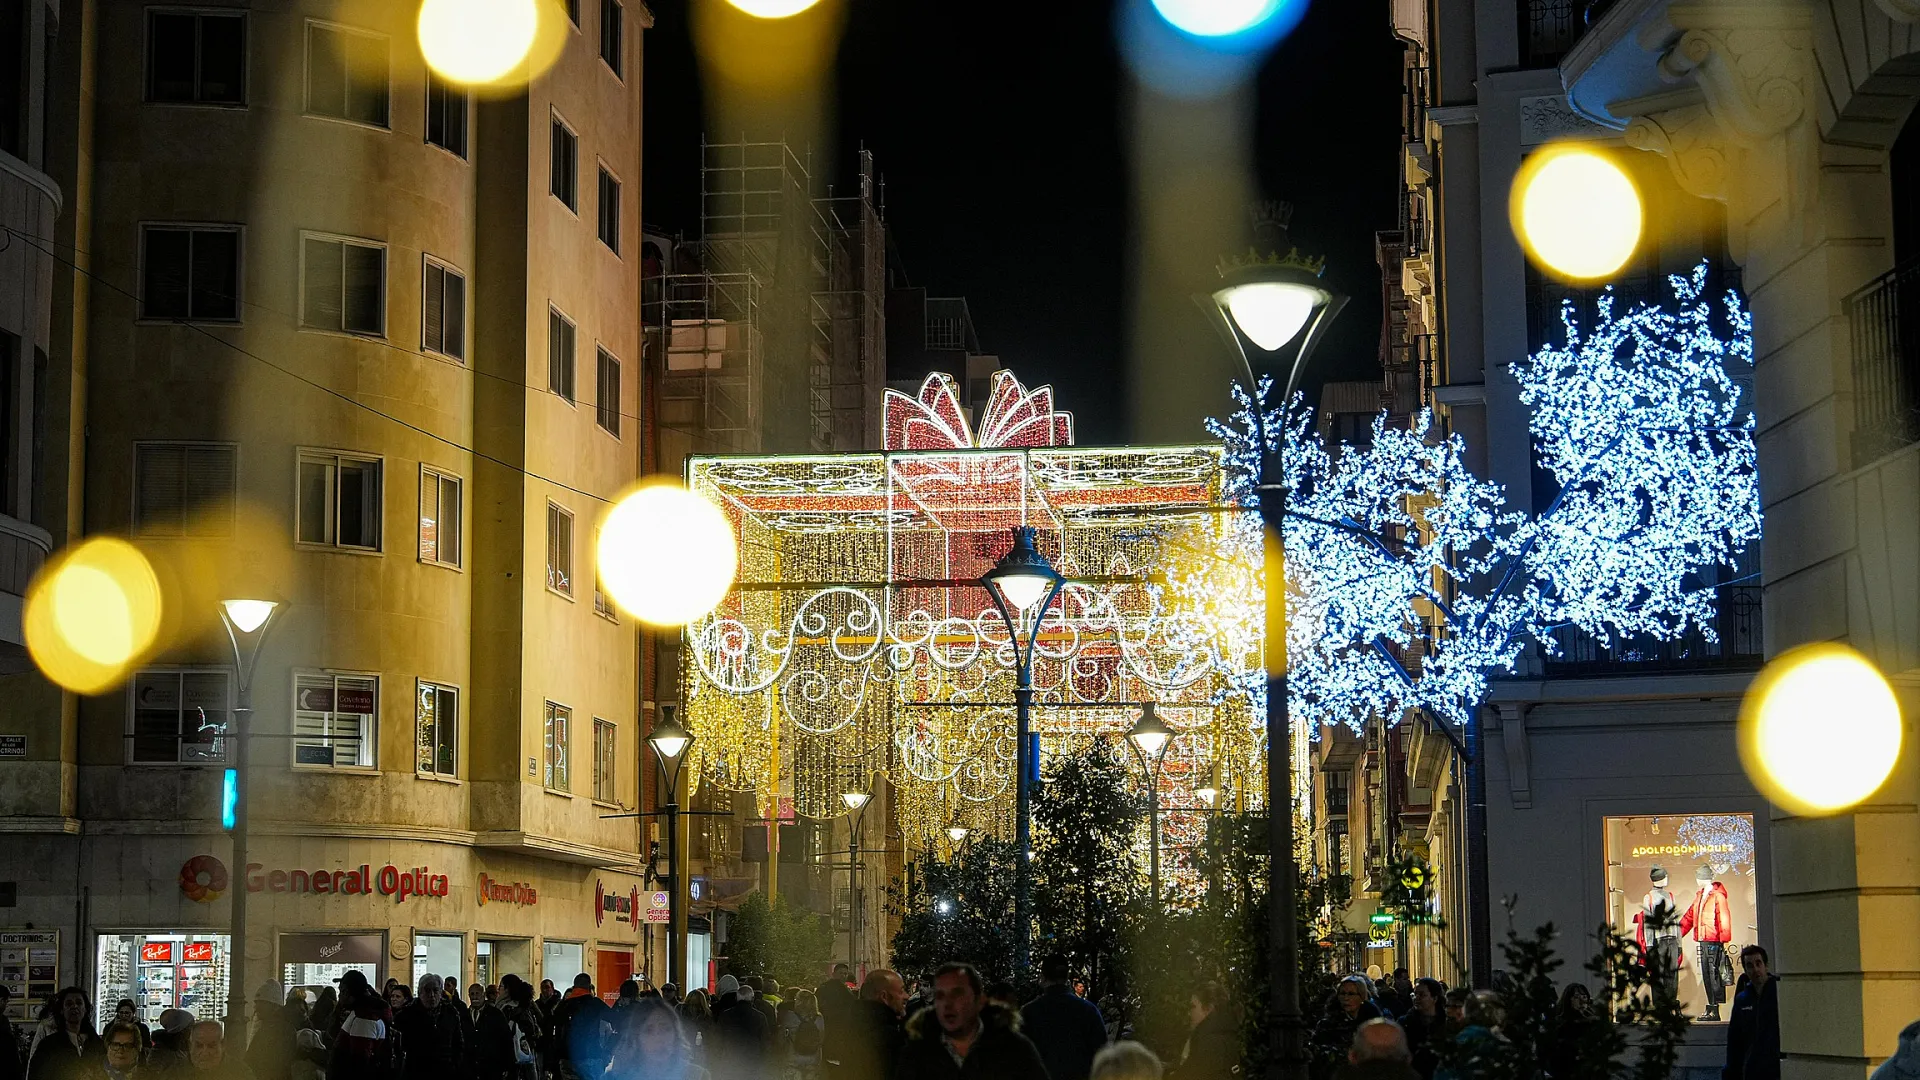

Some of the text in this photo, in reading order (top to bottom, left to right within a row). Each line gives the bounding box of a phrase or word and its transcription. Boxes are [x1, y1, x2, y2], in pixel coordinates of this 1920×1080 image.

[245, 862, 449, 903] General Optica
[3, 934, 55, 943] DOCTRINOS-2
[320, 941, 343, 957] Persol
